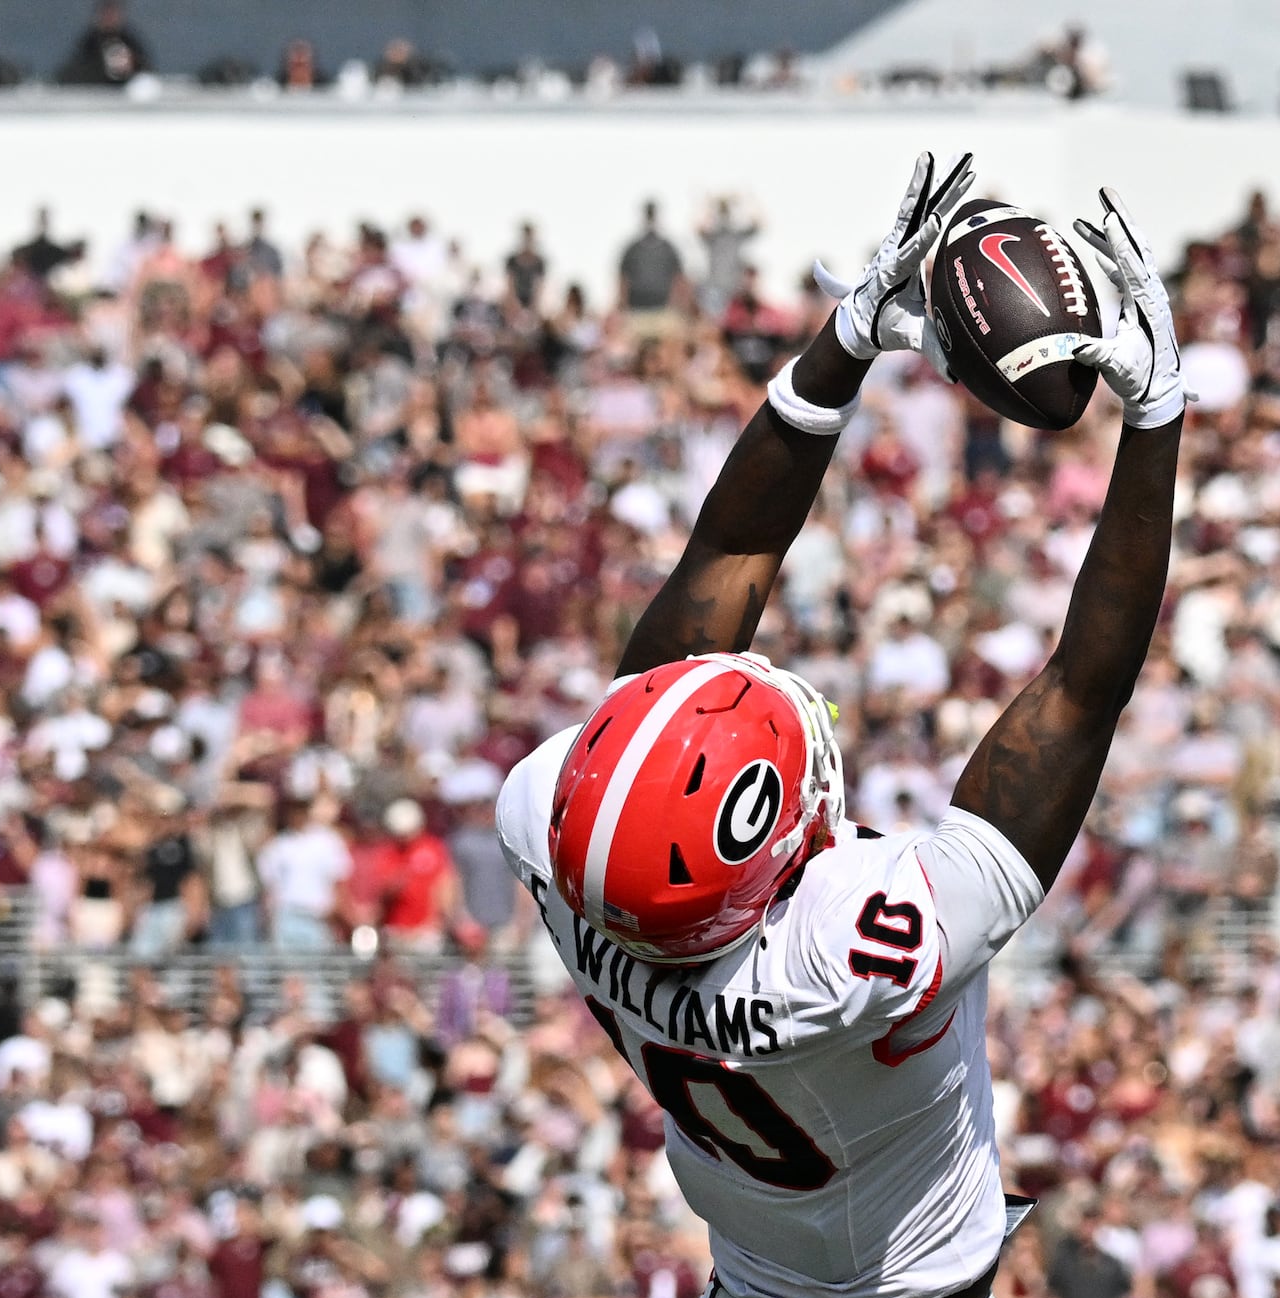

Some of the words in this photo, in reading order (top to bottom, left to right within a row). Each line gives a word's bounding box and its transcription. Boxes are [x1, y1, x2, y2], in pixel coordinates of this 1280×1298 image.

[953, 255, 971, 298] VAPOR
[964, 295, 992, 336] ELITE
[713, 758, 784, 866] G
[573, 911, 785, 1058] WILLIAMS
